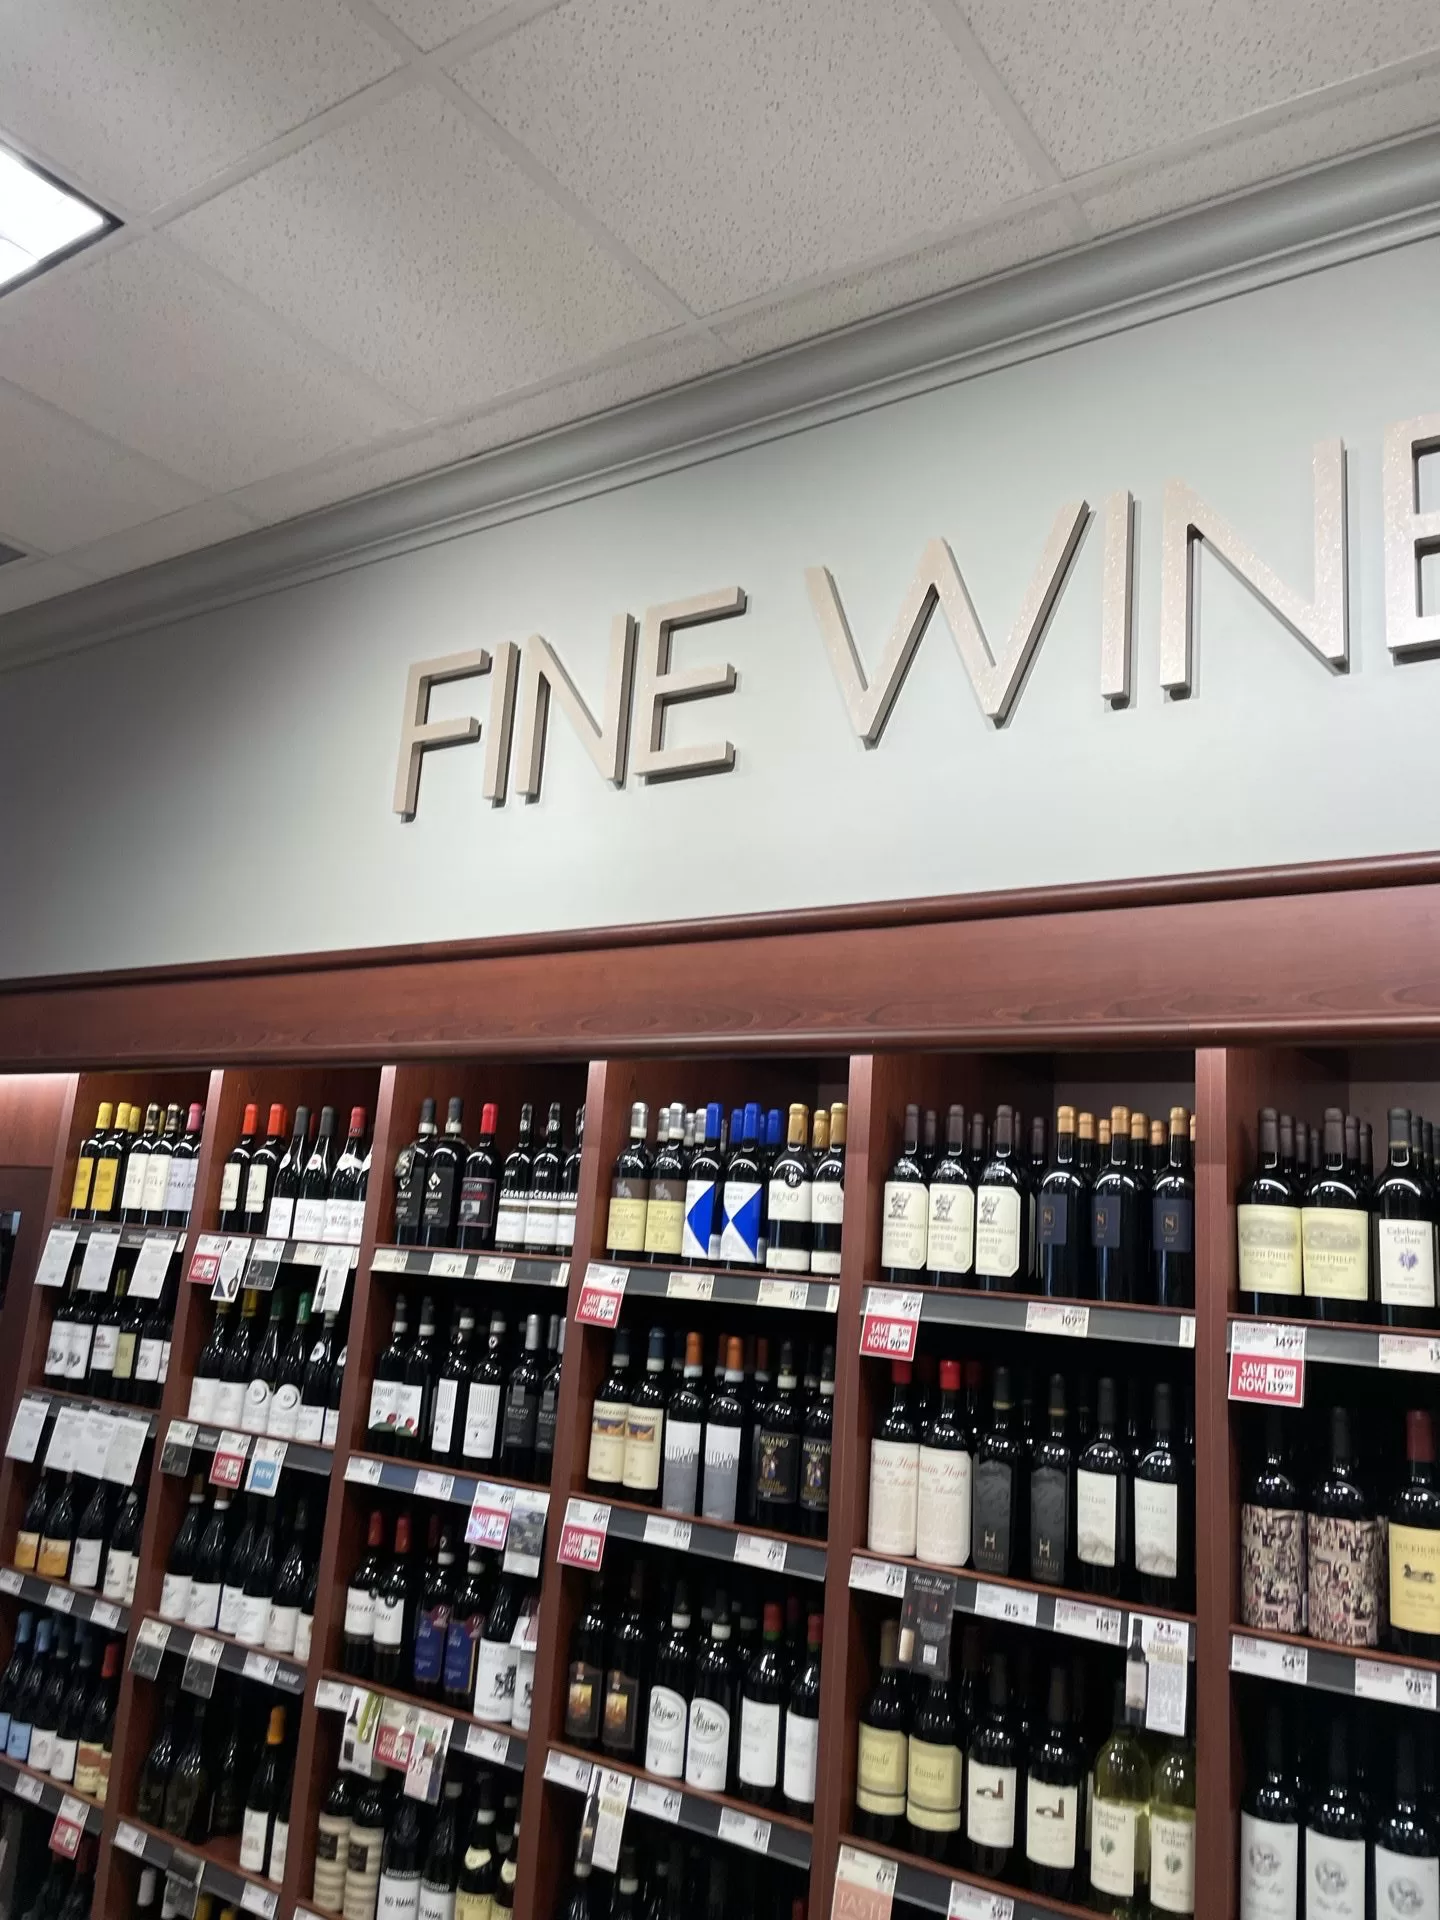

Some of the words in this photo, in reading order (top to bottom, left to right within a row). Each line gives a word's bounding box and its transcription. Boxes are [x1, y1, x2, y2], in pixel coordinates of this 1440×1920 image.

[393, 586, 747, 820] FINE
[586, 1293, 600, 1306] SAVE
[580, 1304, 600, 1318] NOW
[871, 1321, 891, 1337] SAVE
[867, 1335, 891, 1350] NOW
[1241, 1362, 1267, 1381] SAVE
[1238, 1377, 1266, 1395] NOW
[256, 1467, 276, 1481] NEW
